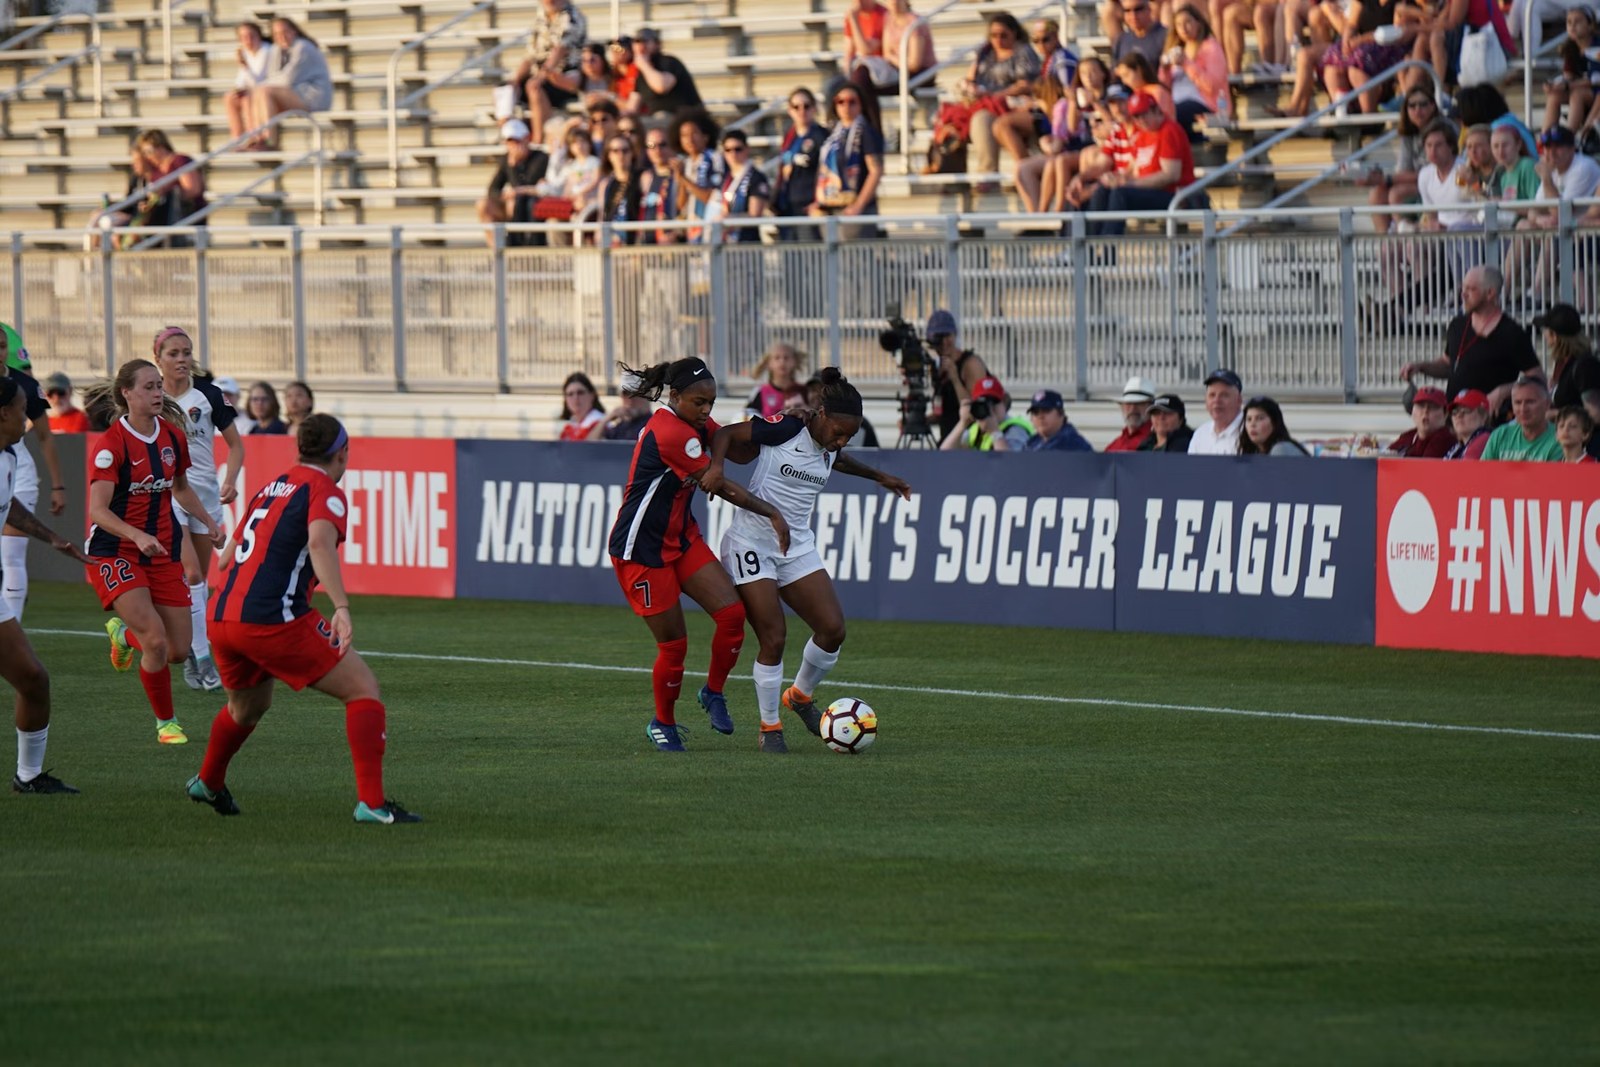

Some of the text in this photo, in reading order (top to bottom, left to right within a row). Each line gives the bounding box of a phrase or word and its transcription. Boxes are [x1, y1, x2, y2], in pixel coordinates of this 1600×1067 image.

[234, 508, 270, 564] 5
[337, 470, 448, 569] ETIME
[735, 550, 761, 578] 19
[934, 495, 1119, 589] SOCCER
[1137, 498, 1342, 599] LEAGUE
[1390, 542, 1436, 562] LIFETIME
[100, 558, 135, 592] 22
[634, 579, 651, 608] 7
